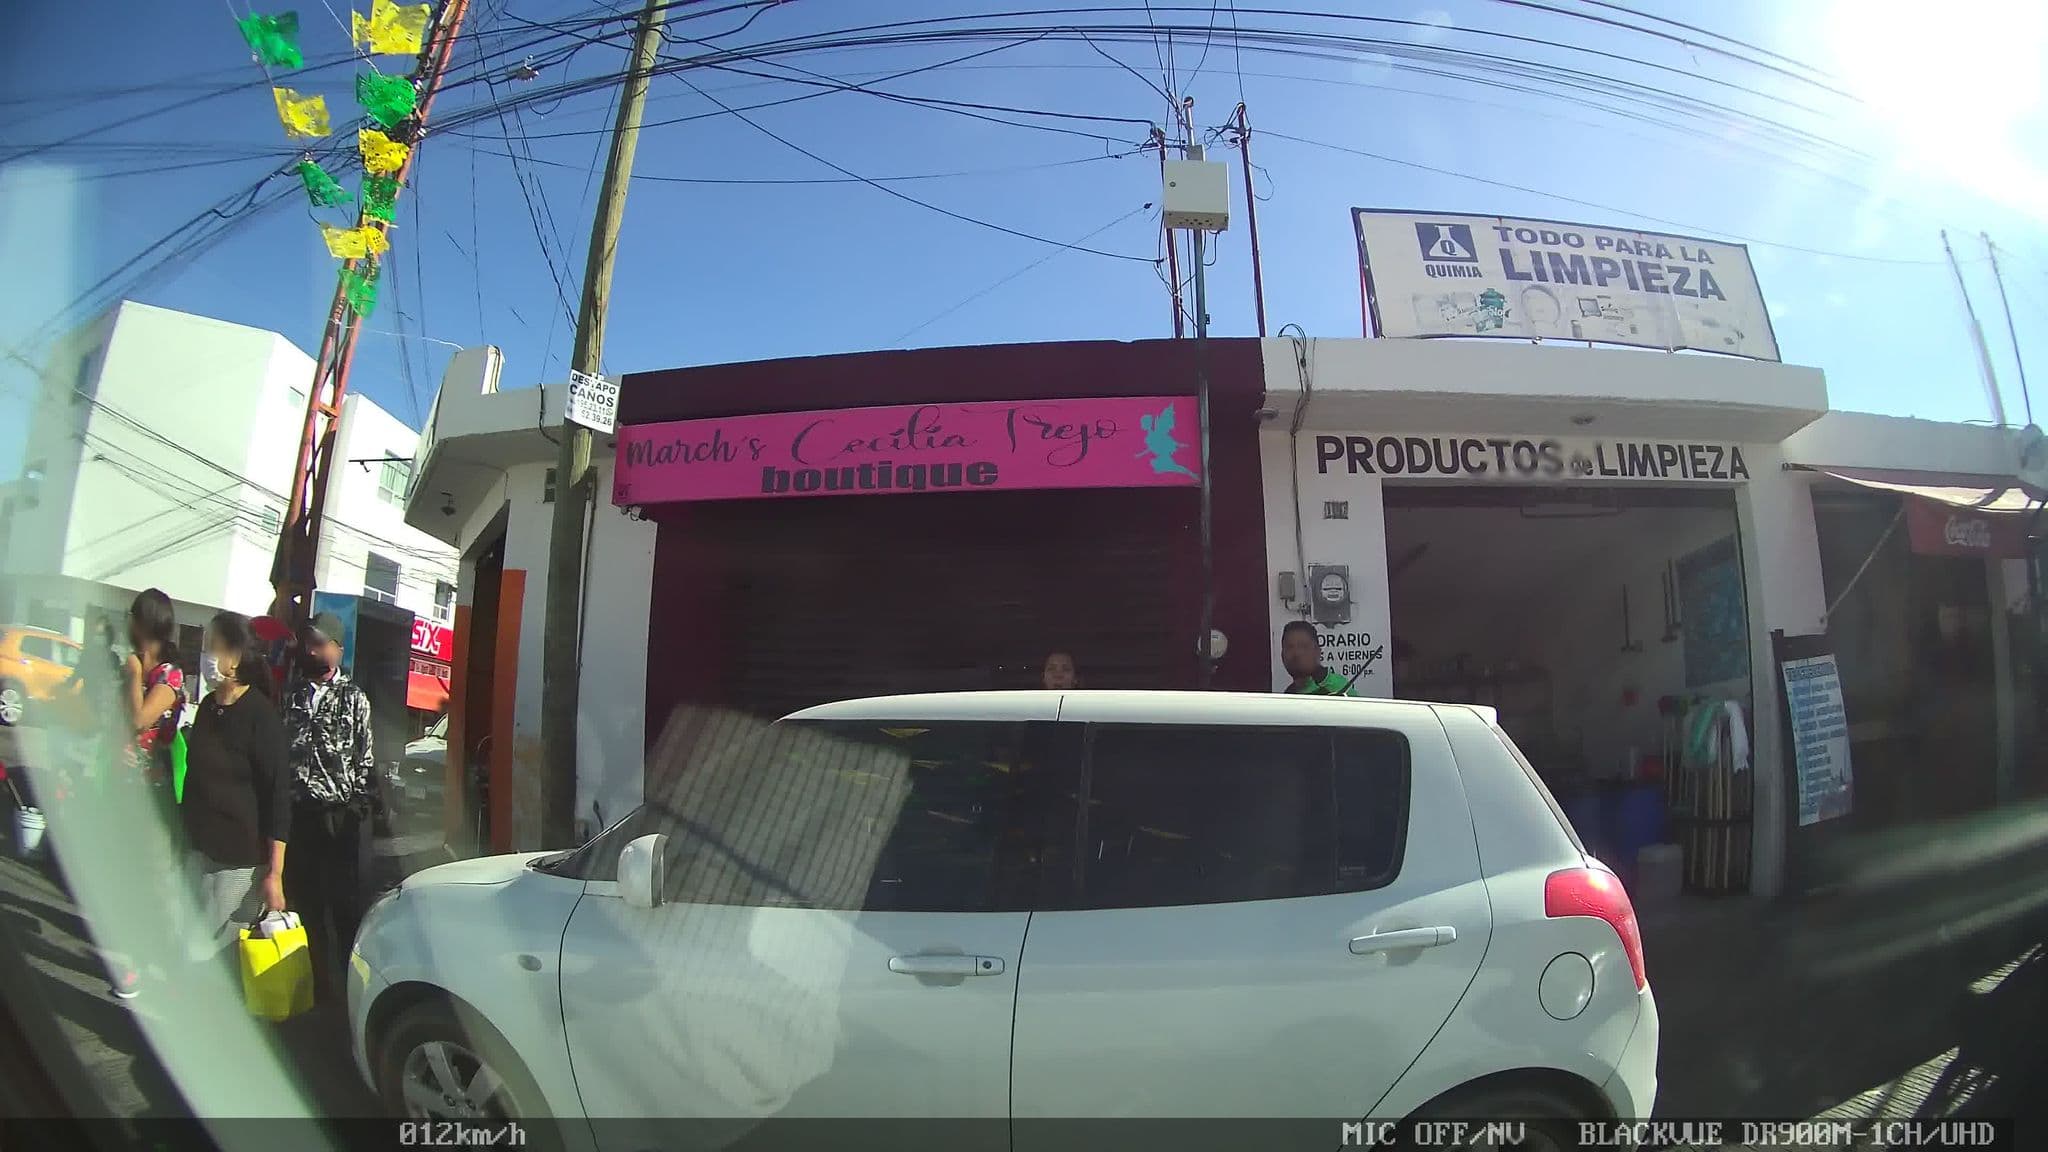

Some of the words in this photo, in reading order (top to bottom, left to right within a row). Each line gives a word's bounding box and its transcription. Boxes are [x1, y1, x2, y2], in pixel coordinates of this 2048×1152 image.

[1492, 226, 1585, 248] TODO
[1595, 235, 1674, 259] PARA
[1680, 246, 1714, 264] LA
[1425, 264, 1483, 278] QUIMIA
[1499, 248, 1727, 301] LIMPIEZA
[791, 406, 977, 464] Cecilia
[961, 405, 1127, 467] Trejo
[1316, 435, 1563, 474] PRODUCTOS
[1596, 441, 1750, 480] LIMPIEZA
[761, 461, 998, 493] boutique
[1317, 633, 1371, 648] ORARIO
[1327, 652, 1334, 661] A
[1338, 650, 1383, 661] VIERNES
